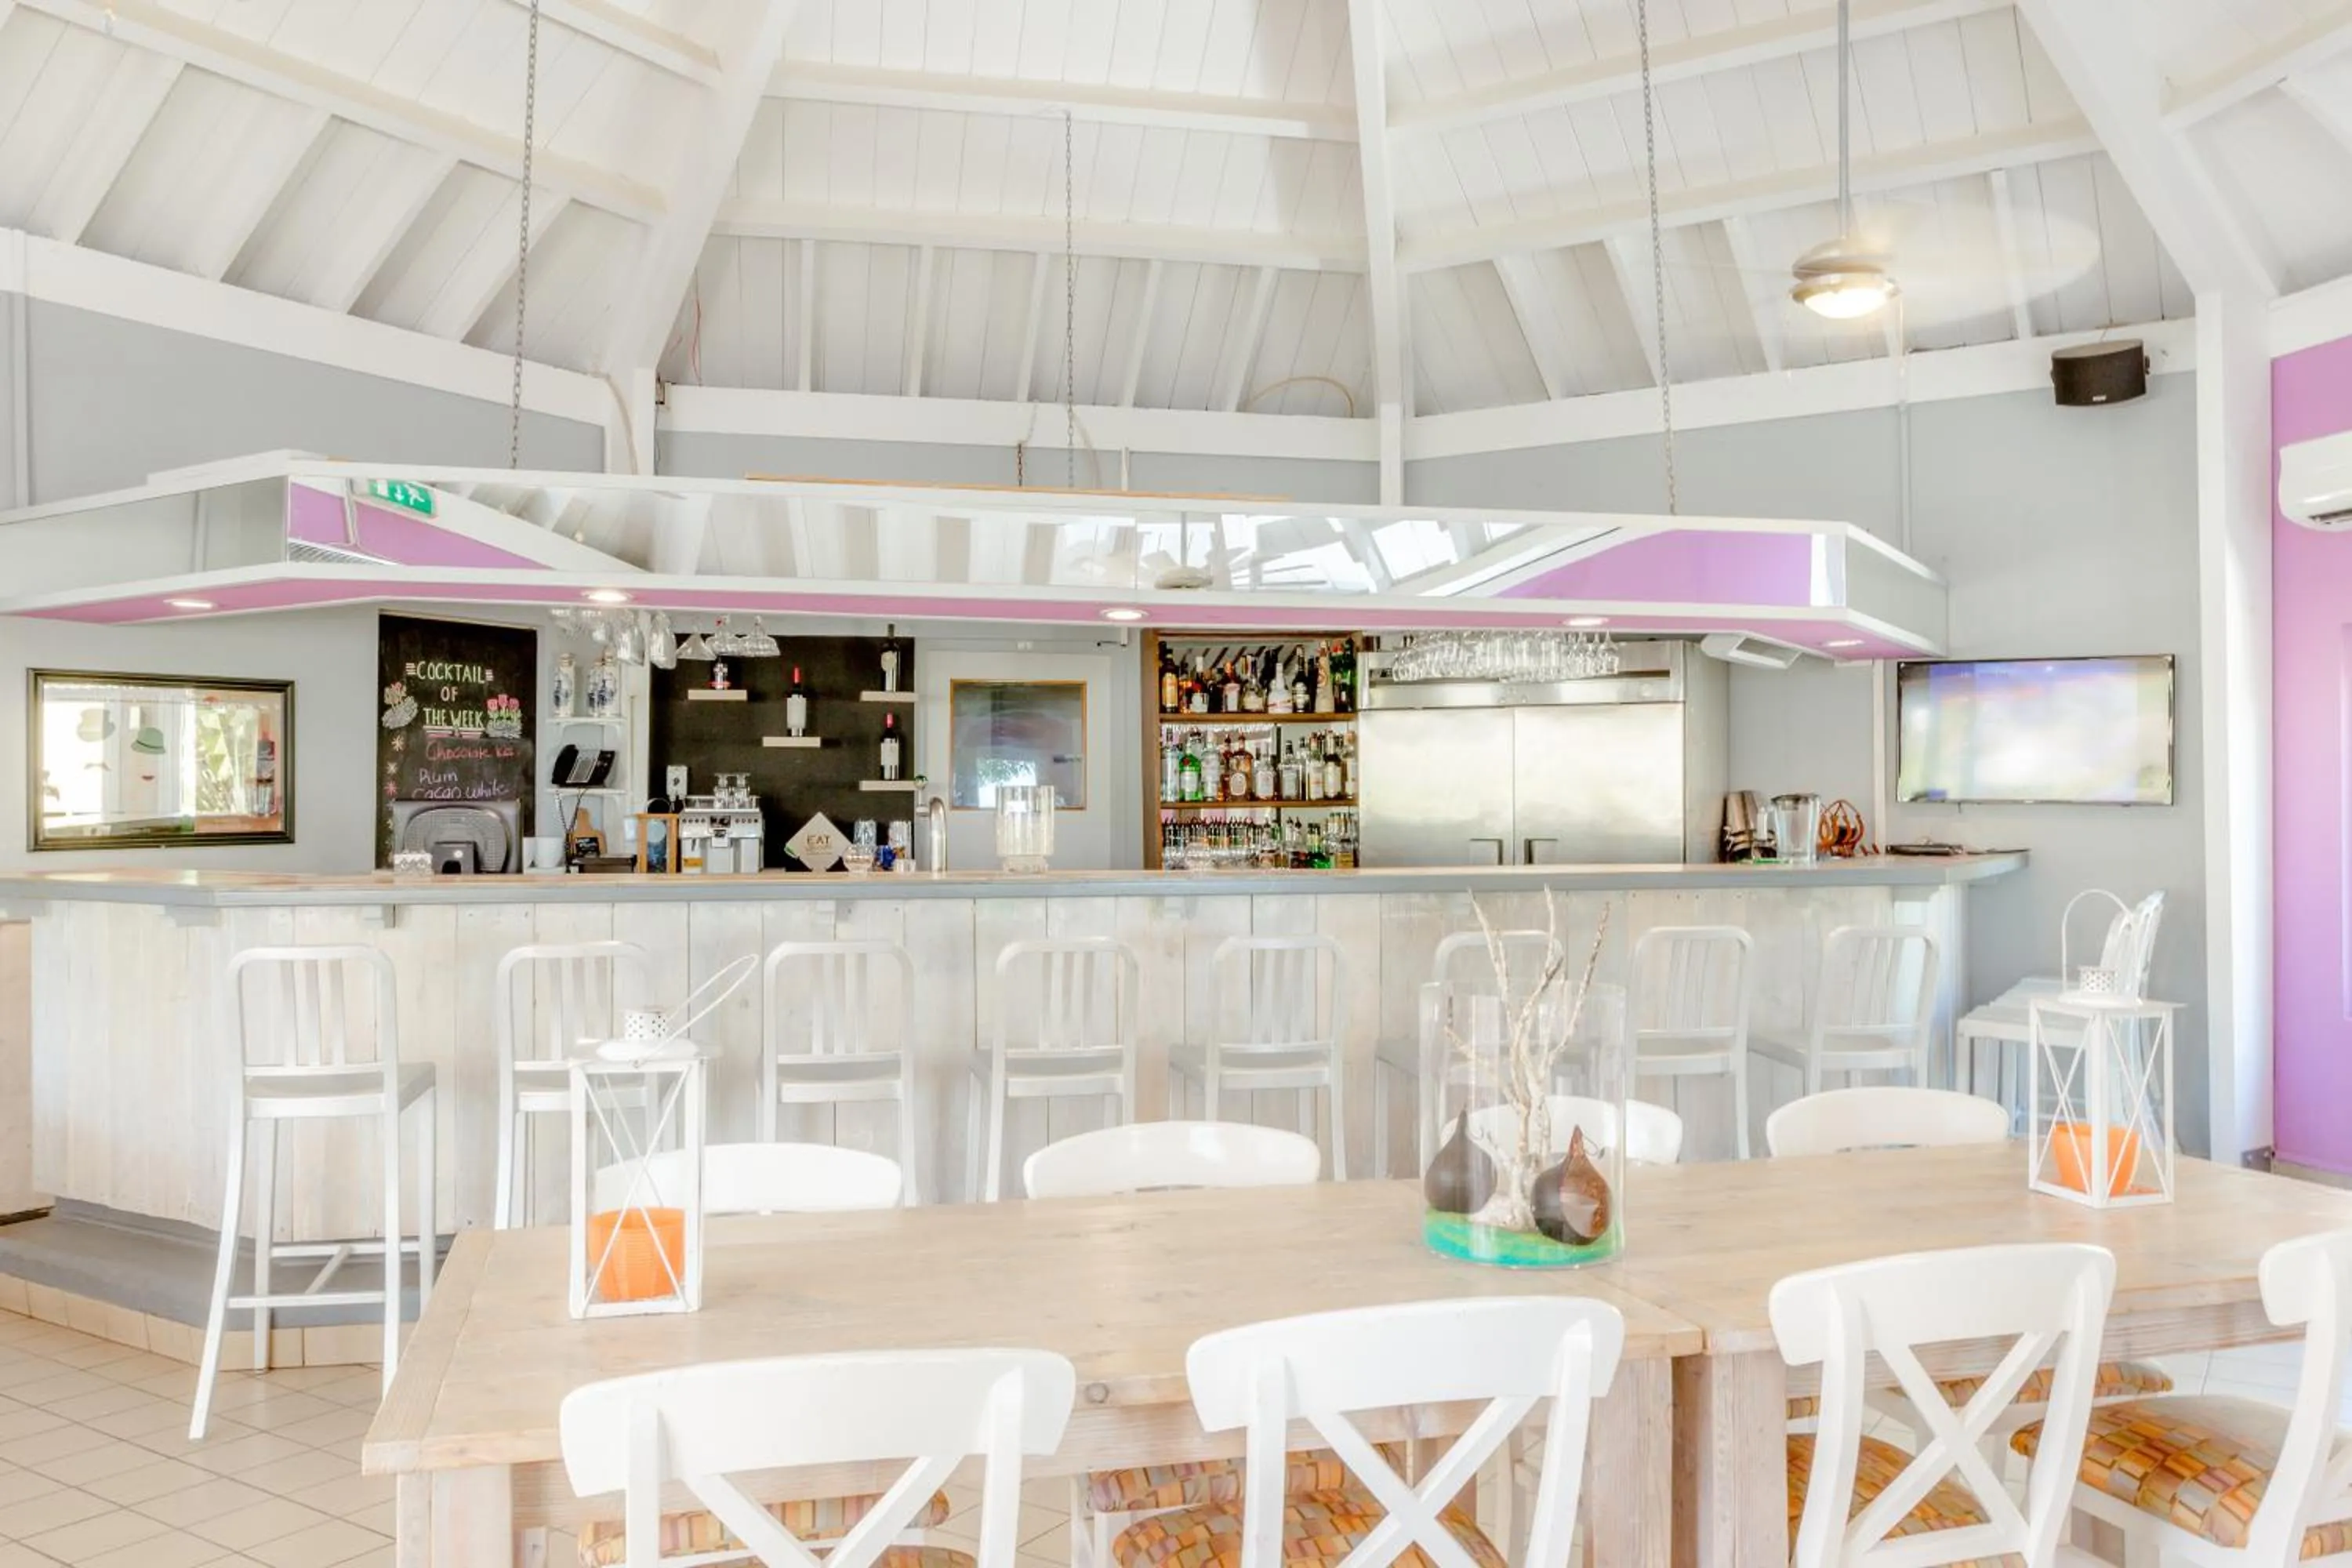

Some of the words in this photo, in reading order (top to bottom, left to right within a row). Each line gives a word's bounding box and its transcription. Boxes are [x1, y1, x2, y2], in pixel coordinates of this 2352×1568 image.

[416, 661, 485, 684] COCKTAIL
[440, 686, 458, 702] OF
[423, 707, 447, 727] THE
[449, 710, 485, 728] WEEK
[419, 768, 459, 784] Rum
